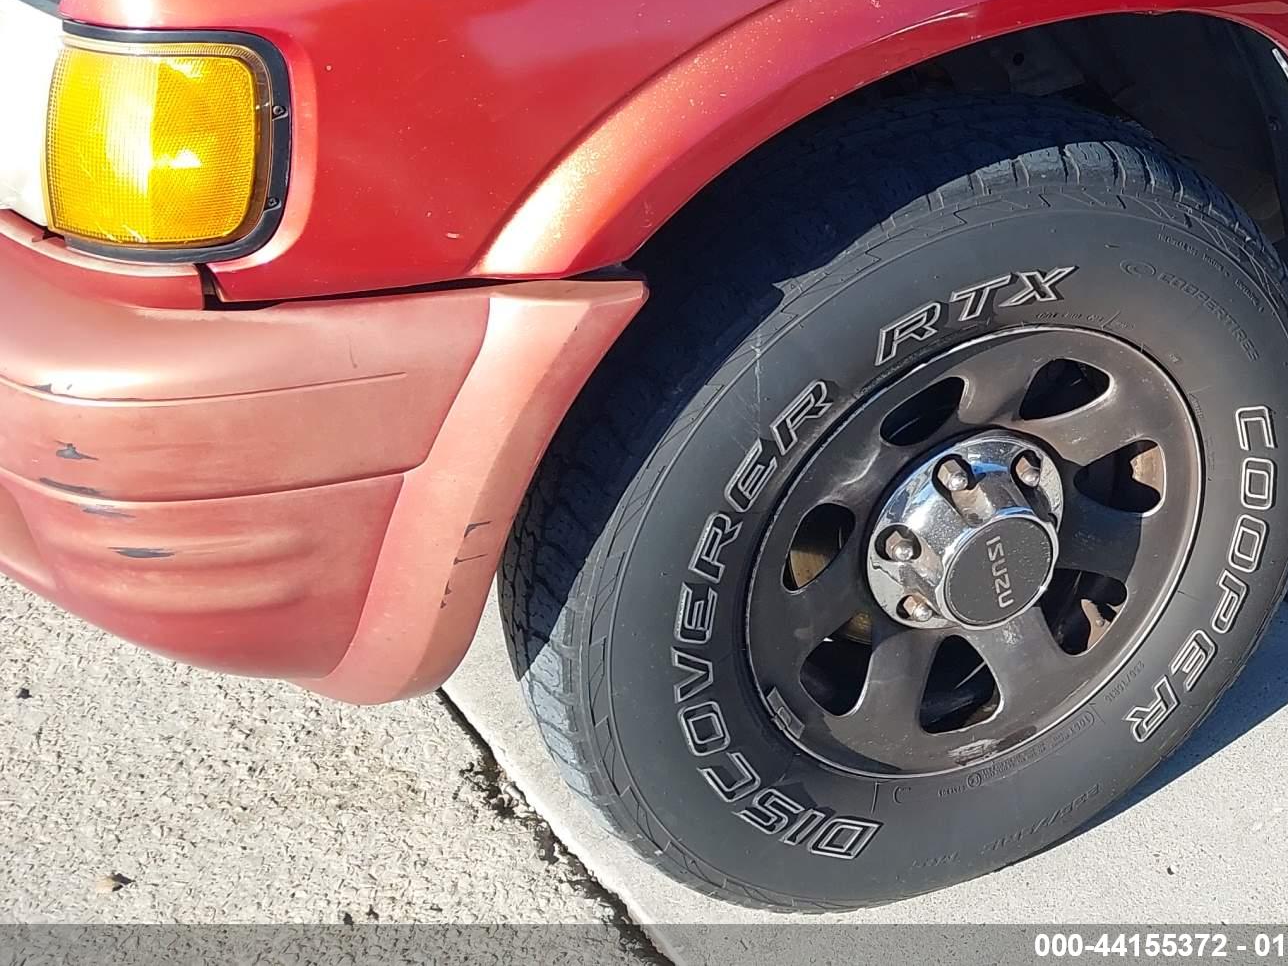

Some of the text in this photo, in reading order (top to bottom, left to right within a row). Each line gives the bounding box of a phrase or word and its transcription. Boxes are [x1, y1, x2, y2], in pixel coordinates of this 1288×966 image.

[671, 266, 1079, 861] DISCOVERER RTX
[985, 535, 1016, 608] ISUZU
[1123, 404, 1277, 744] COOPER
